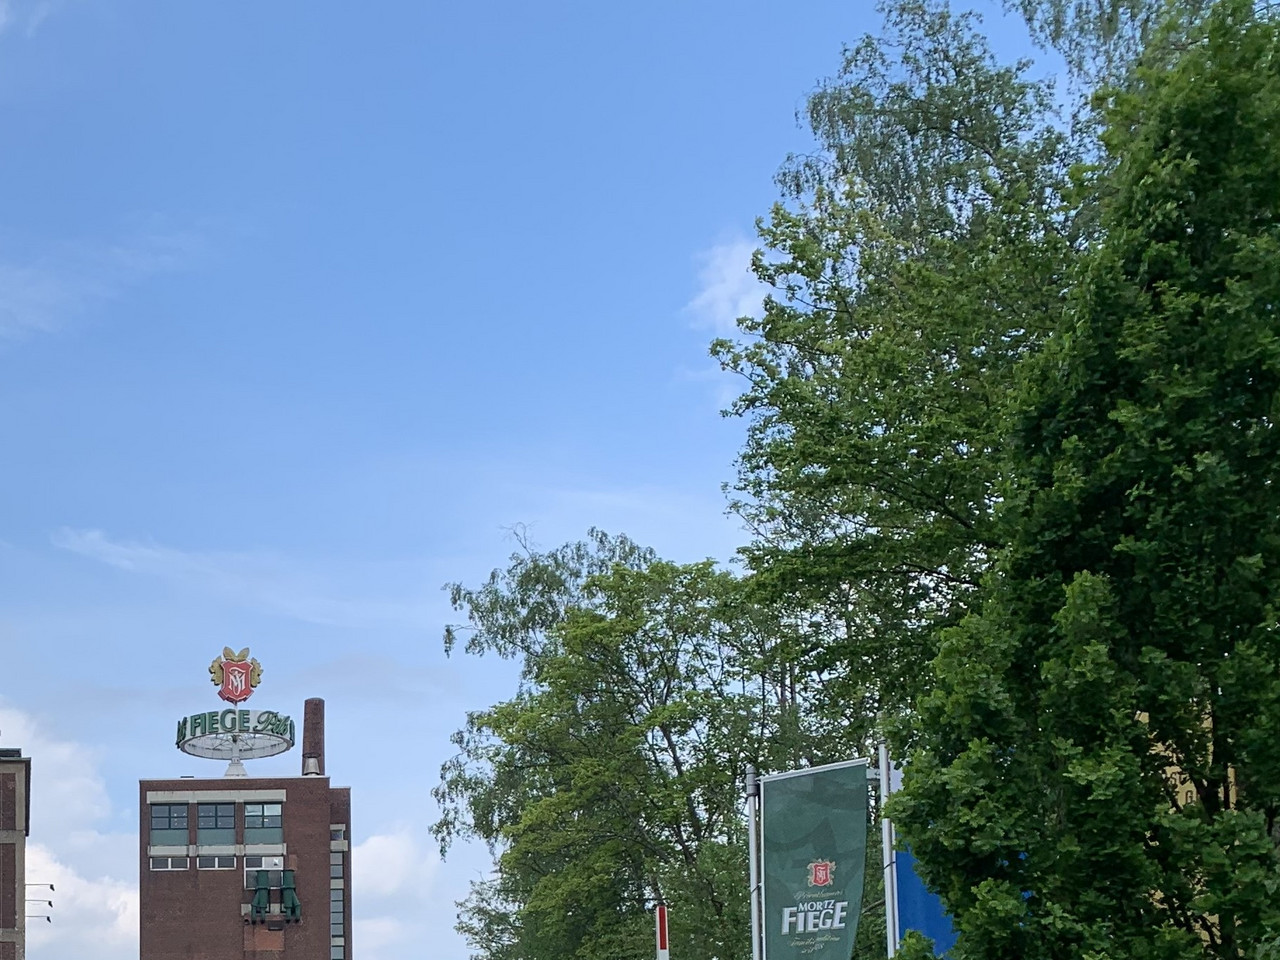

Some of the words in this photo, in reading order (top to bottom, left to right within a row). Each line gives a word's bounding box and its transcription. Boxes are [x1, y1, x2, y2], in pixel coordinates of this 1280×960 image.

[190, 708, 250, 737] FIEGE
[781, 901, 848, 935] FIEGE
[798, 899, 836, 912] MORTZ
